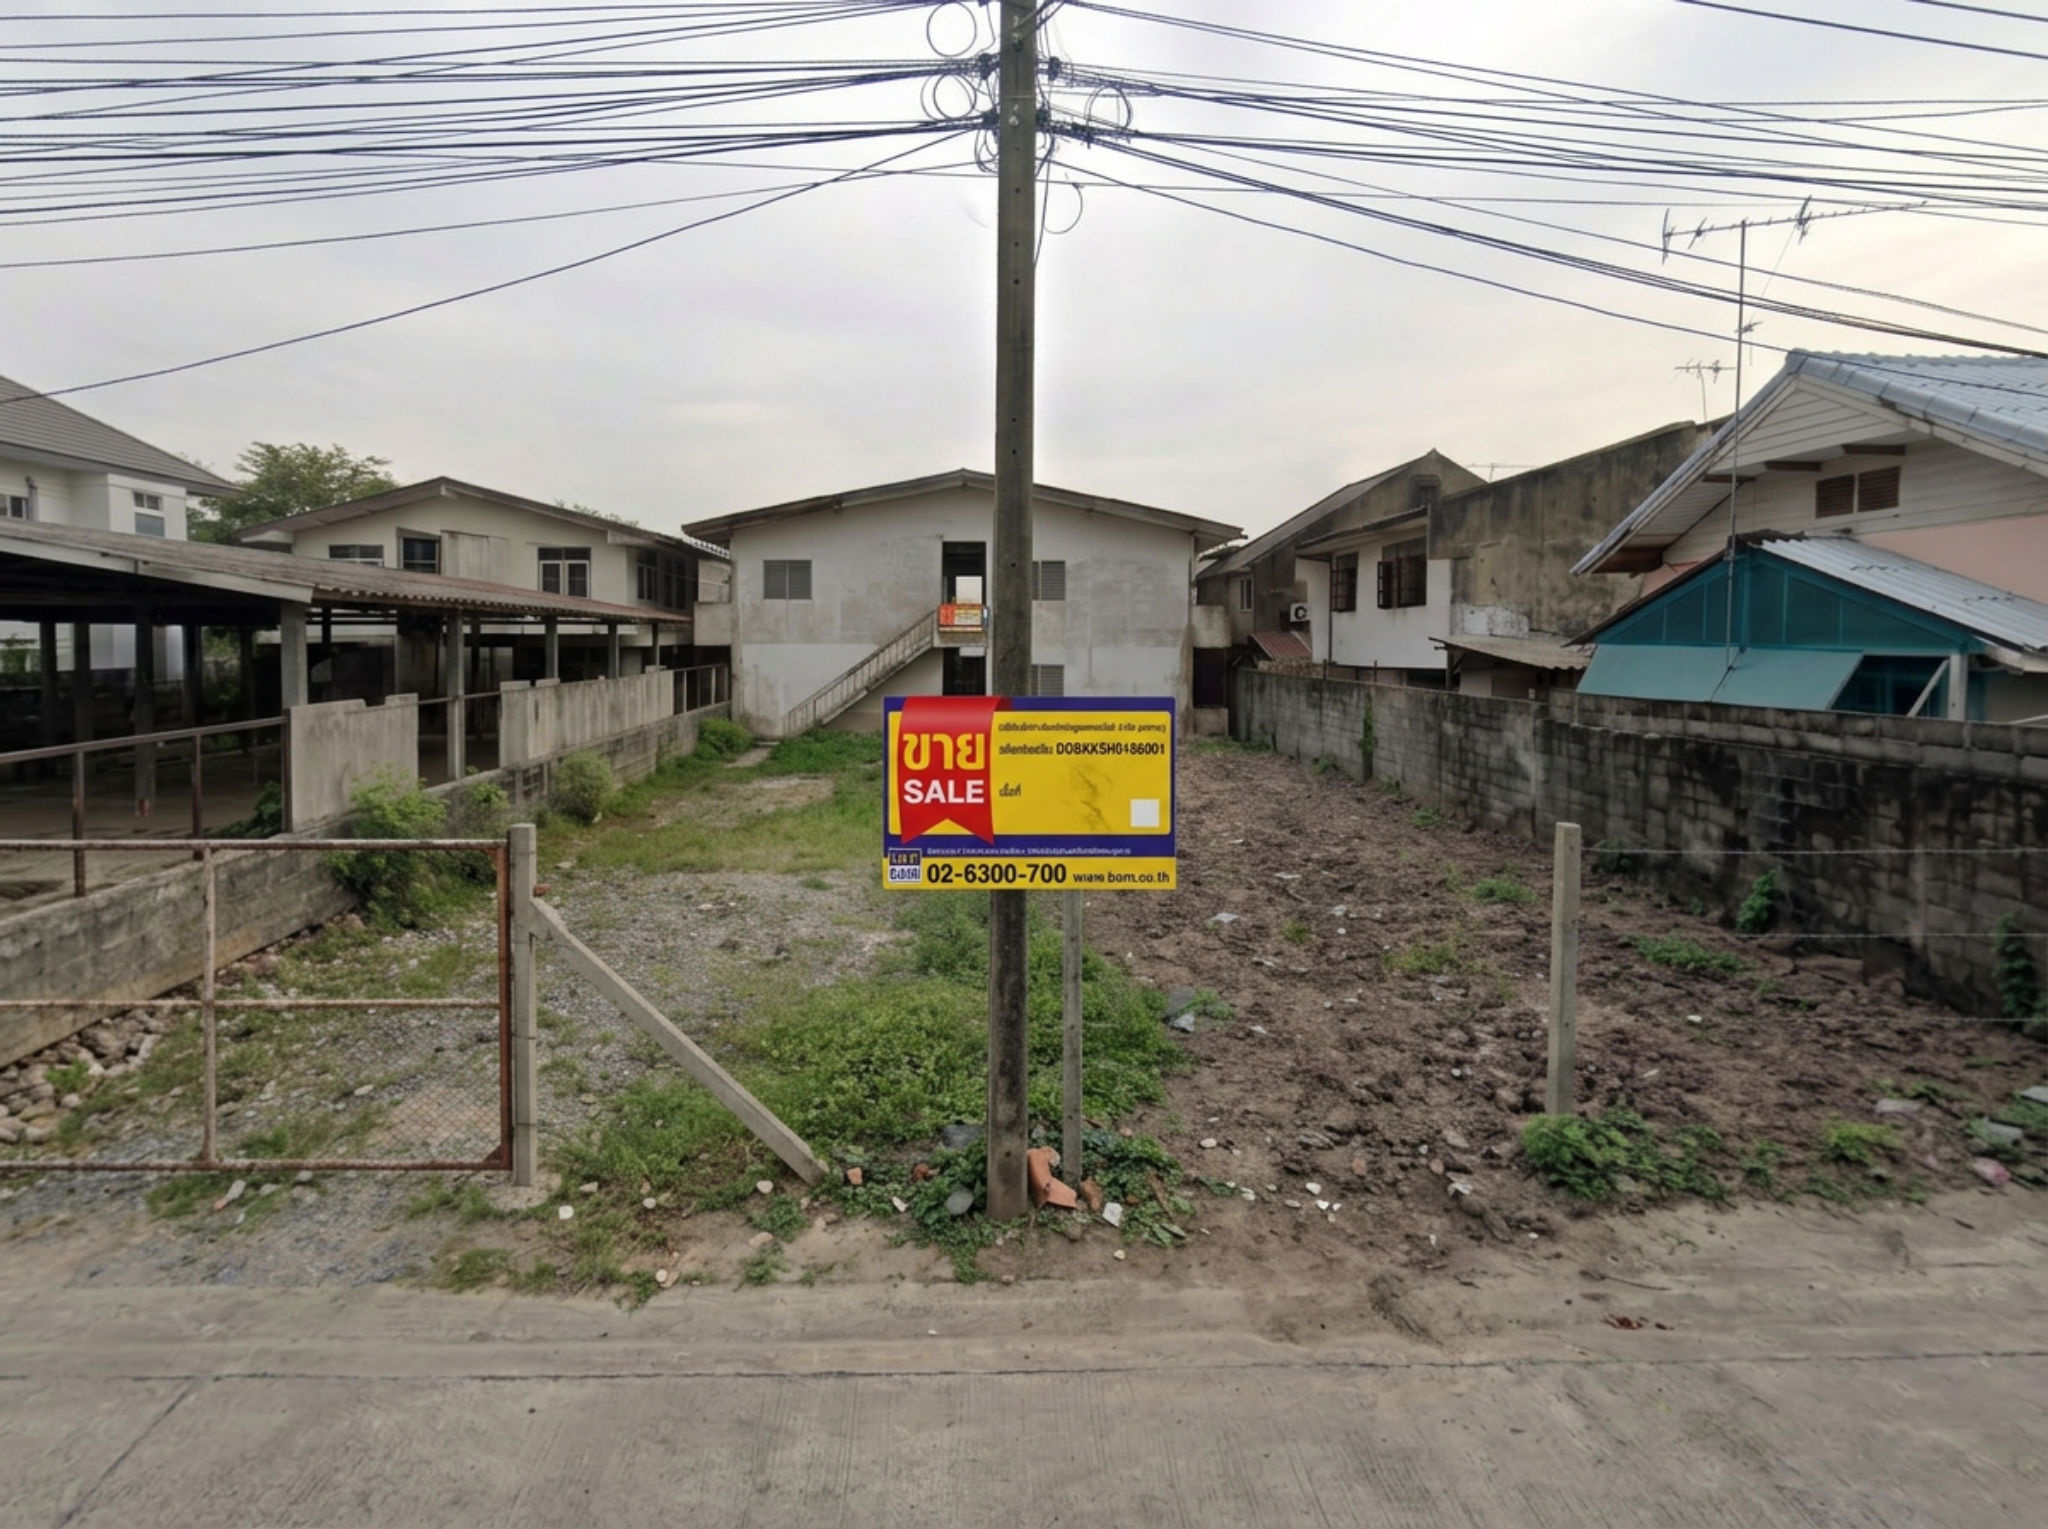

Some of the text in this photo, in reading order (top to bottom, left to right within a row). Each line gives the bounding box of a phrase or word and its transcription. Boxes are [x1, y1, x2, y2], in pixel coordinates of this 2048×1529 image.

[902, 732, 985, 771] ขาย
[903, 778, 985, 804] SALE
[926, 863, 1067, 884] 02-6300-700
